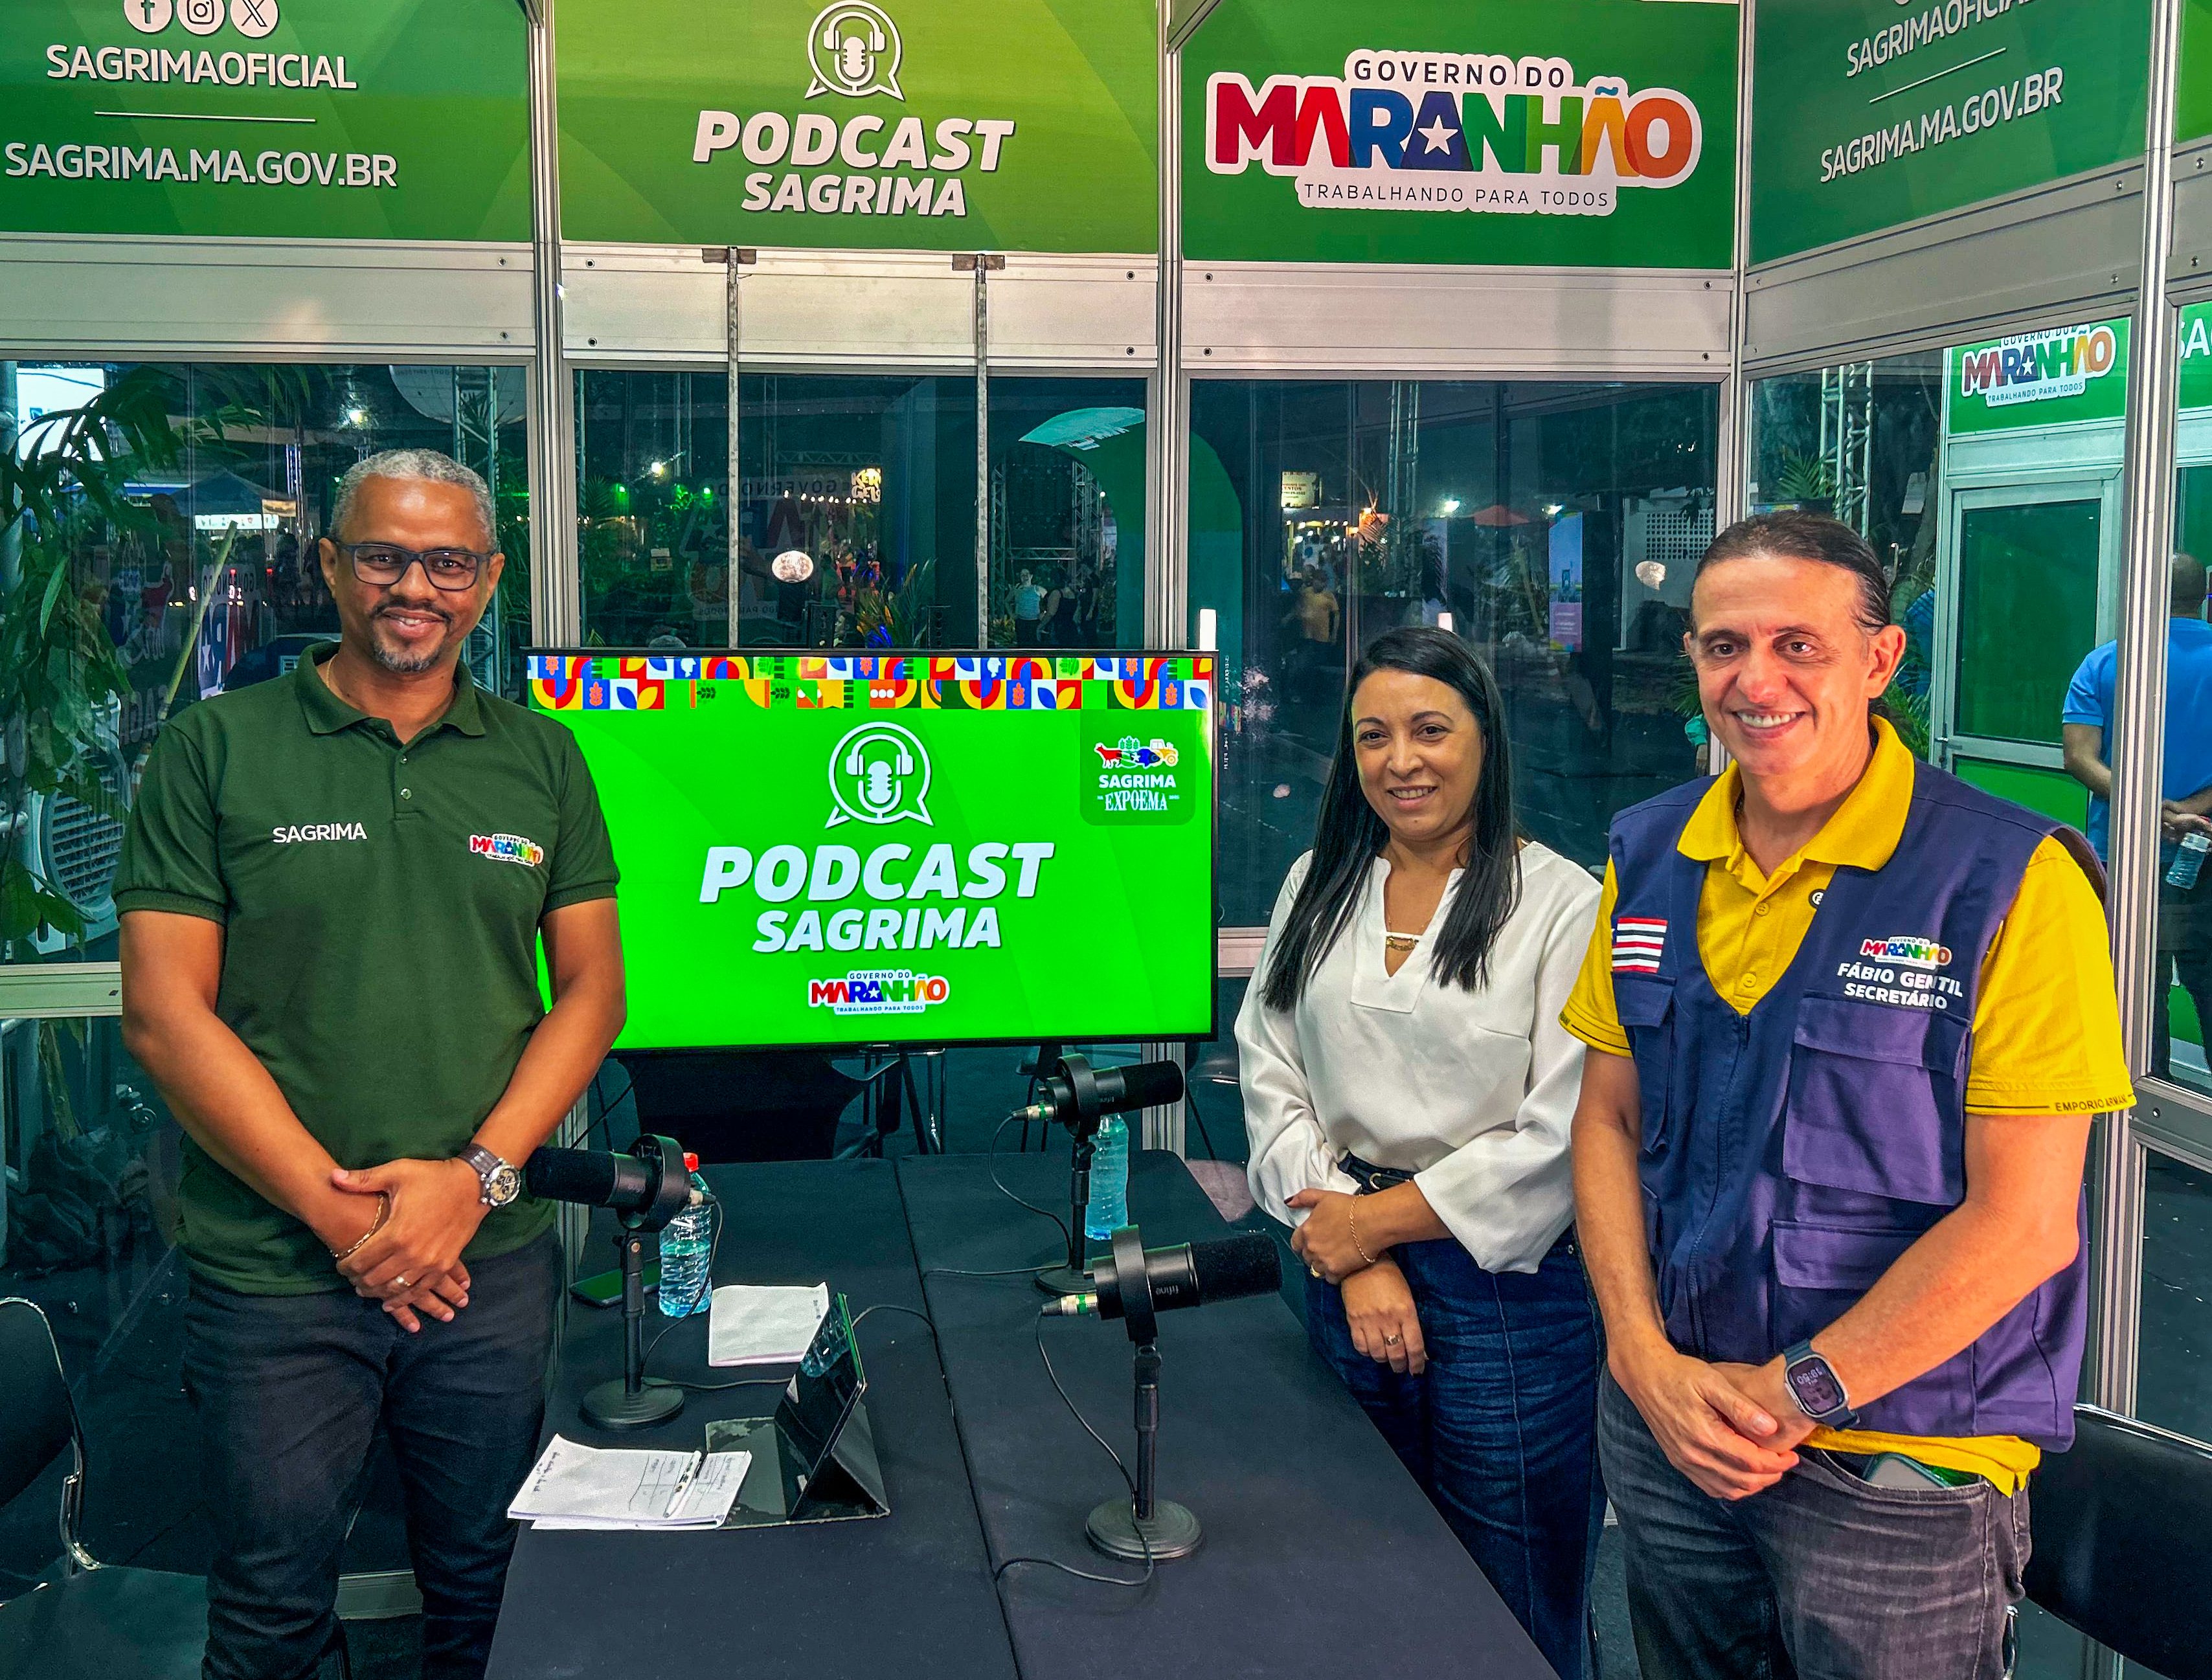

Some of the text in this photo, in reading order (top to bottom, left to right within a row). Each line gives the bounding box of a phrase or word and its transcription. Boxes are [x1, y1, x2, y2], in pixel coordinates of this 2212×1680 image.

[46, 44, 357, 89] SAGRIMAOFICIAL
[1354, 59, 1565, 88] GOVERNO DO
[693, 111, 1015, 171] PODCAST
[1215, 82, 1693, 179] MARANHÃO
[1820, 67, 2064, 183] SAGRIMA.MA.GOV.BR
[5, 143, 398, 187] SAGRIMA.MA.GOV.BR
[741, 173, 966, 216] SAGRIMA
[1304, 184, 1608, 207] TRABALHANDO PARA TODOS
[1964, 330, 2112, 392] MARANHÃO
[1989, 382, 2082, 402] TRABALHANDO PARA TODOS
[1099, 774, 1177, 789] SAGRIMA
[1105, 789, 1168, 811] EXPOEMA
[273, 822, 367, 843] SAGRIMA
[699, 843, 1054, 902] PODCAST
[752, 908, 1001, 952] SAGRIMA
[812, 976, 947, 1004] MARANHÃO
[1837, 962, 1895, 983] FÁBIO
[1900, 972, 1963, 997] GENTIL
[1844, 983, 1947, 1009] SECRETÁRIO
[2055, 1099, 2105, 1112] EMPORIO
